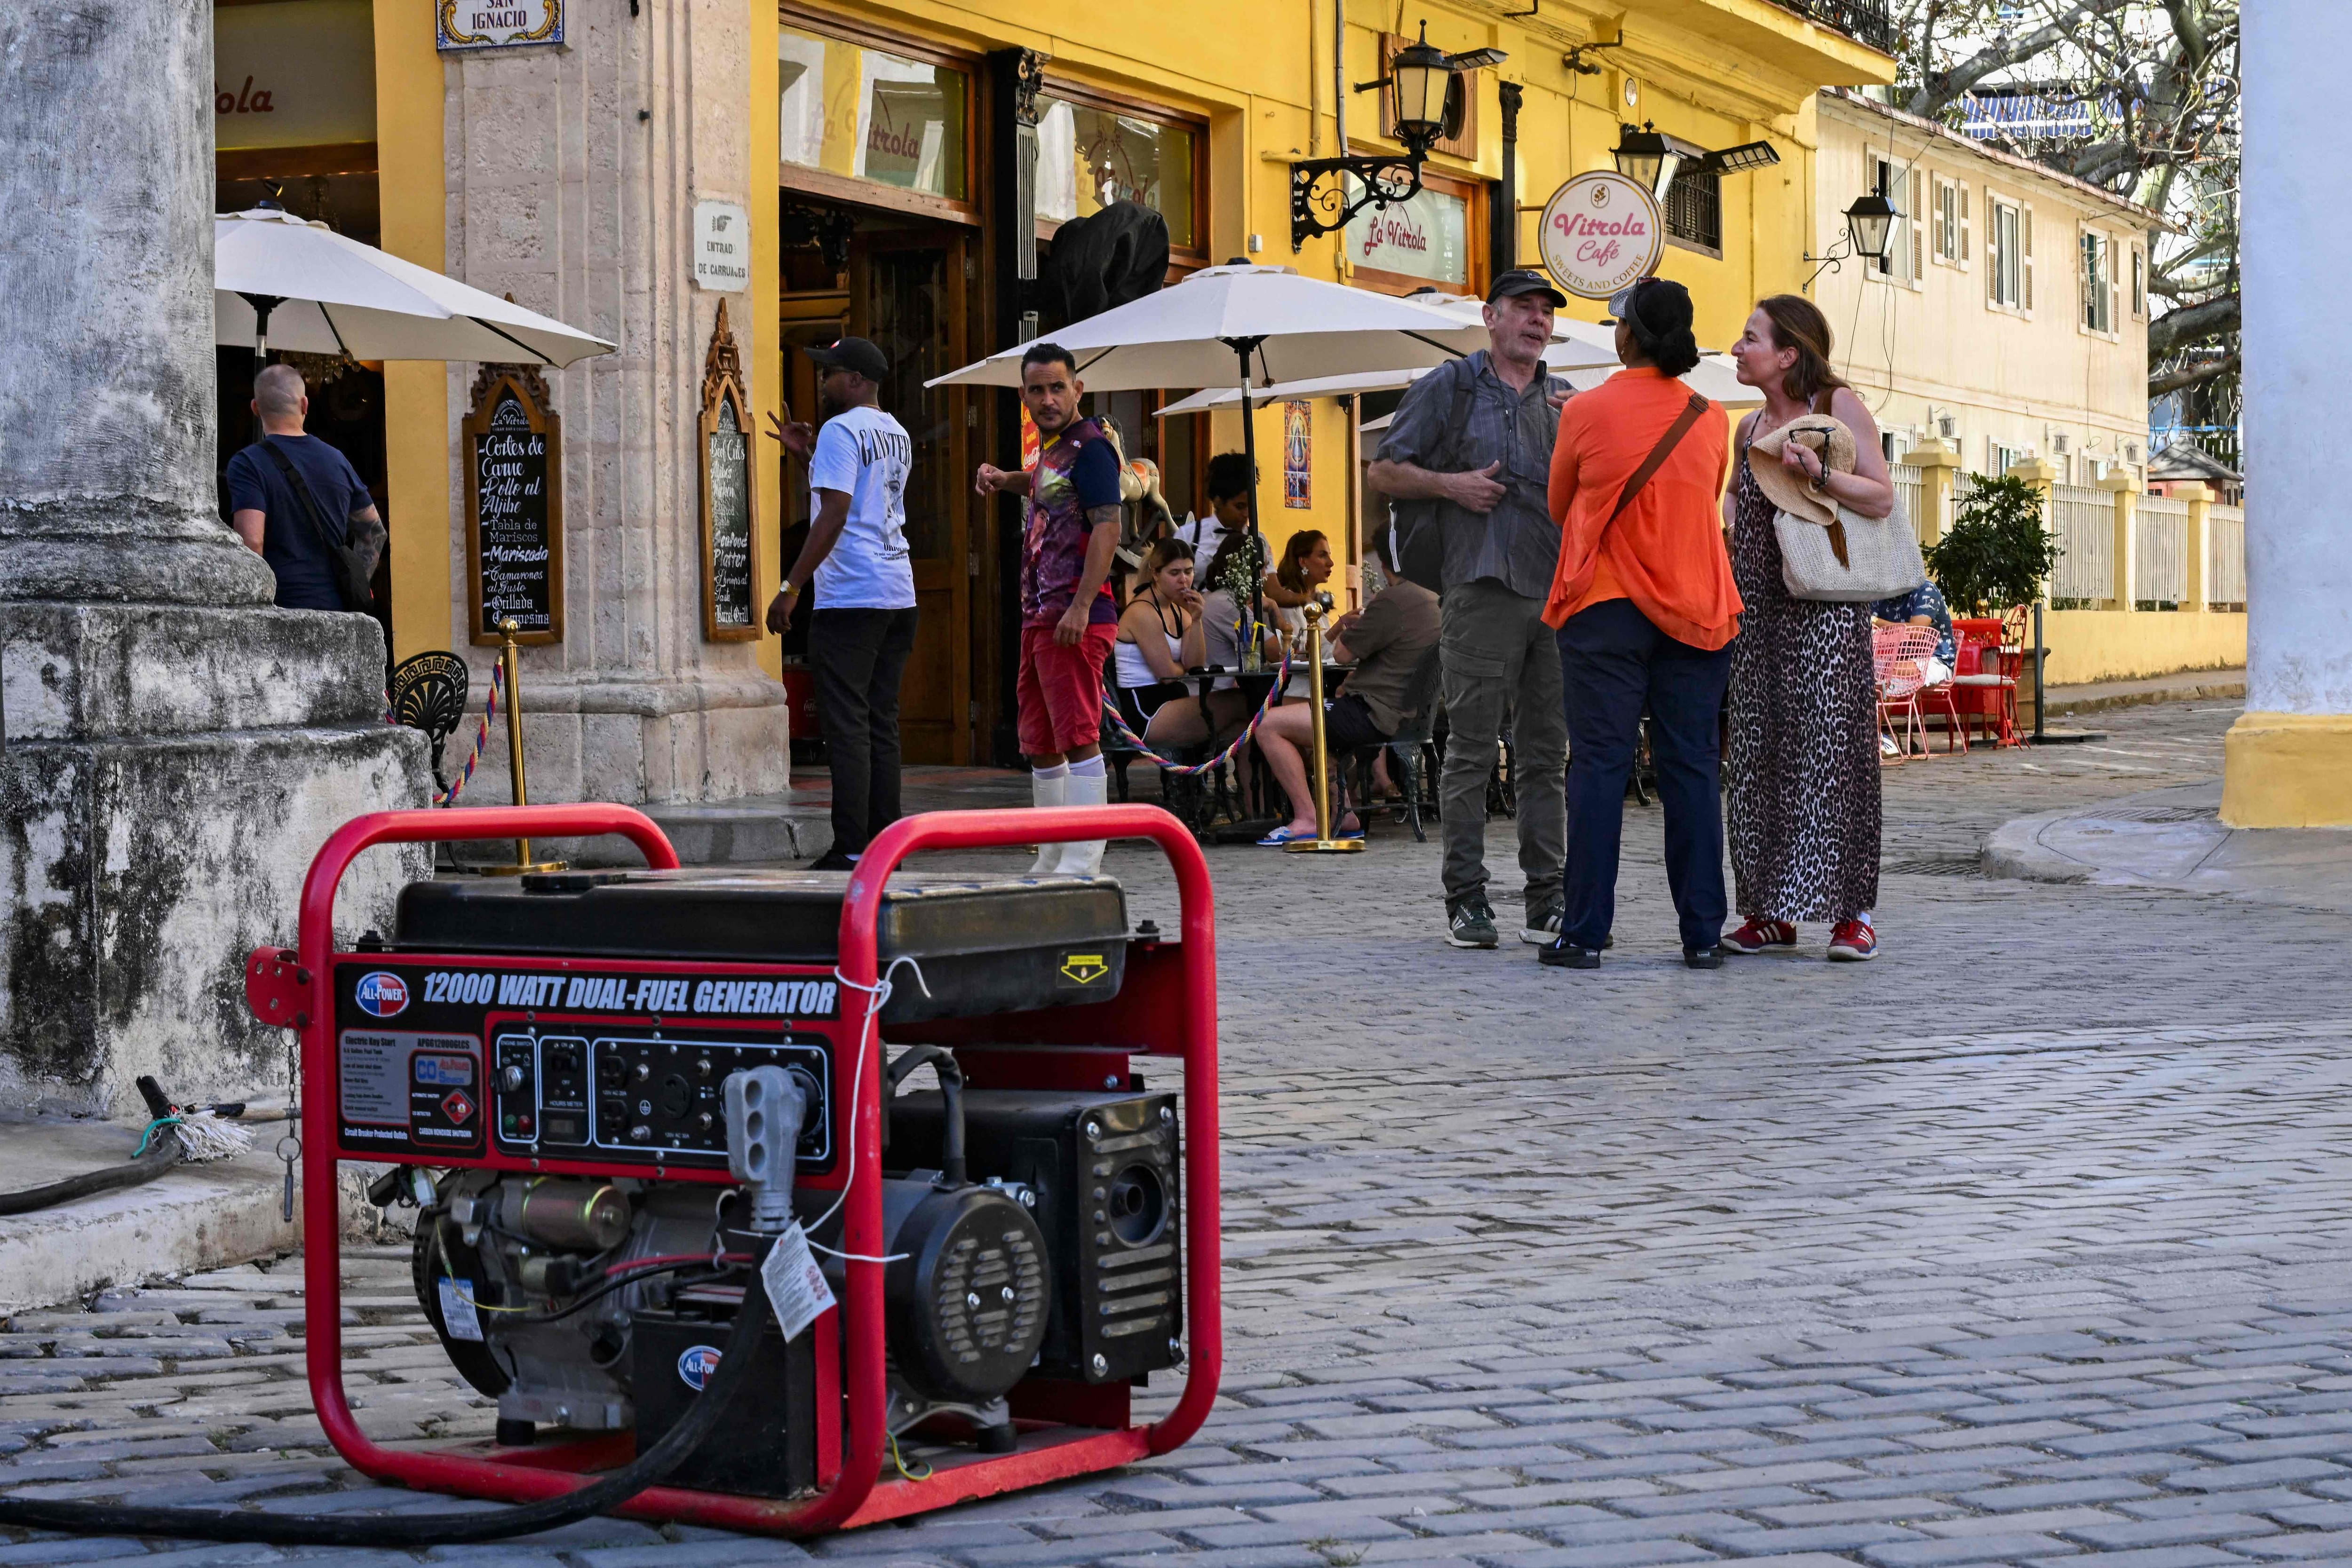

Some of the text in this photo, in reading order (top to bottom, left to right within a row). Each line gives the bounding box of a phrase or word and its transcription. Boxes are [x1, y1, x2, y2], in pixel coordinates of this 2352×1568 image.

[472, 10, 527, 29] IGNACIO
[215, 75, 274, 114] ola
[1554, 213, 1645, 237] Vitrola
[1364, 216, 1427, 256] La Vitrola
[1577, 240, 1621, 267] Café
[699, 263, 707, 274] DE
[1553, 254, 1645, 290] SWEETS AND COFFEE
[491, 413, 503, 426] La
[528, 435, 546, 455] de
[727, 439, 745, 461] Cuts
[482, 458, 525, 477] Carne
[525, 476, 540, 495] al
[481, 495, 522, 519] Aljibe
[524, 518, 537, 530] de
[489, 532, 538, 542] Mariscos
[713, 530, 748, 548] Seafood
[714, 548, 747, 568] Platter
[487, 580, 526, 594] al Gusto
[741, 572, 747, 585] at
[715, 584, 731, 602] Taste
[733, 605, 748, 623] Grill
[361, 984, 403, 1002] ALL-POWER
[424, 972, 837, 1014] 12000 WATT DUAL-FUEL GENERATOR
[345, 1036, 396, 1046] Electric Key Start
[417, 1060, 437, 1080] CO
